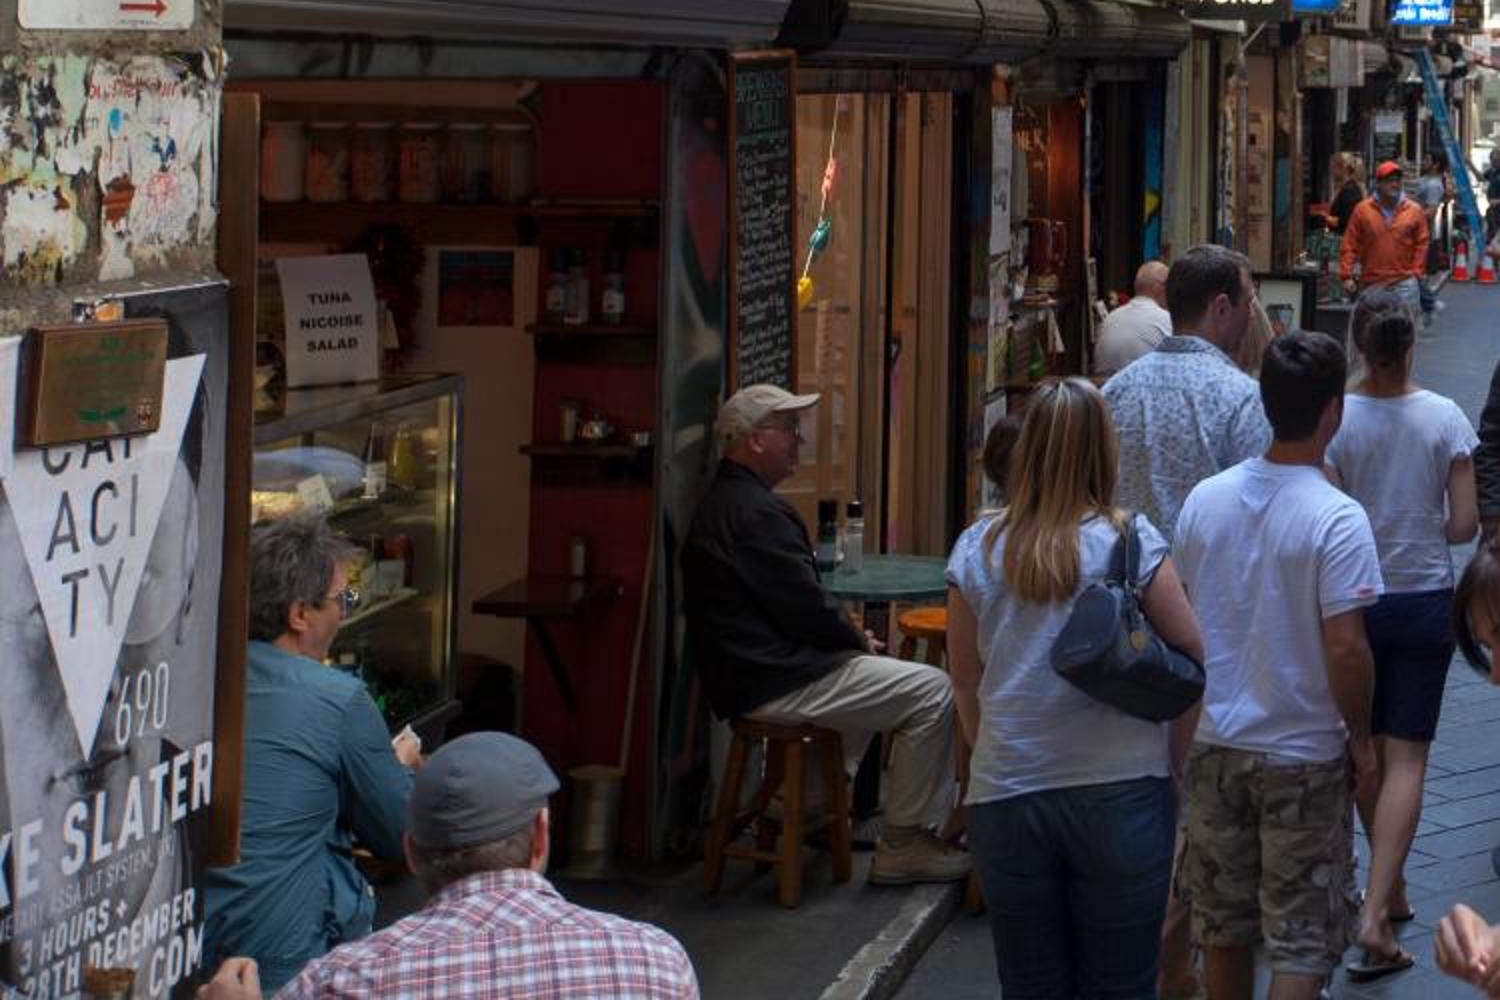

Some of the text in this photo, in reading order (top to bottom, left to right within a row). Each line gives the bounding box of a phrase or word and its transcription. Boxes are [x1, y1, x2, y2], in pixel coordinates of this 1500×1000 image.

[299, 313, 364, 331] NICOISE
[308, 291, 352, 306] TUNA
[306, 336, 360, 353] SALAD
[46, 473, 138, 562] ACI
[61, 557, 125, 638] TY
[115, 660, 170, 746] 690
[61, 740, 214, 877] SLATER
[40, 896, 111, 967] HOURS
[89, 886, 197, 969] DECEMBER
